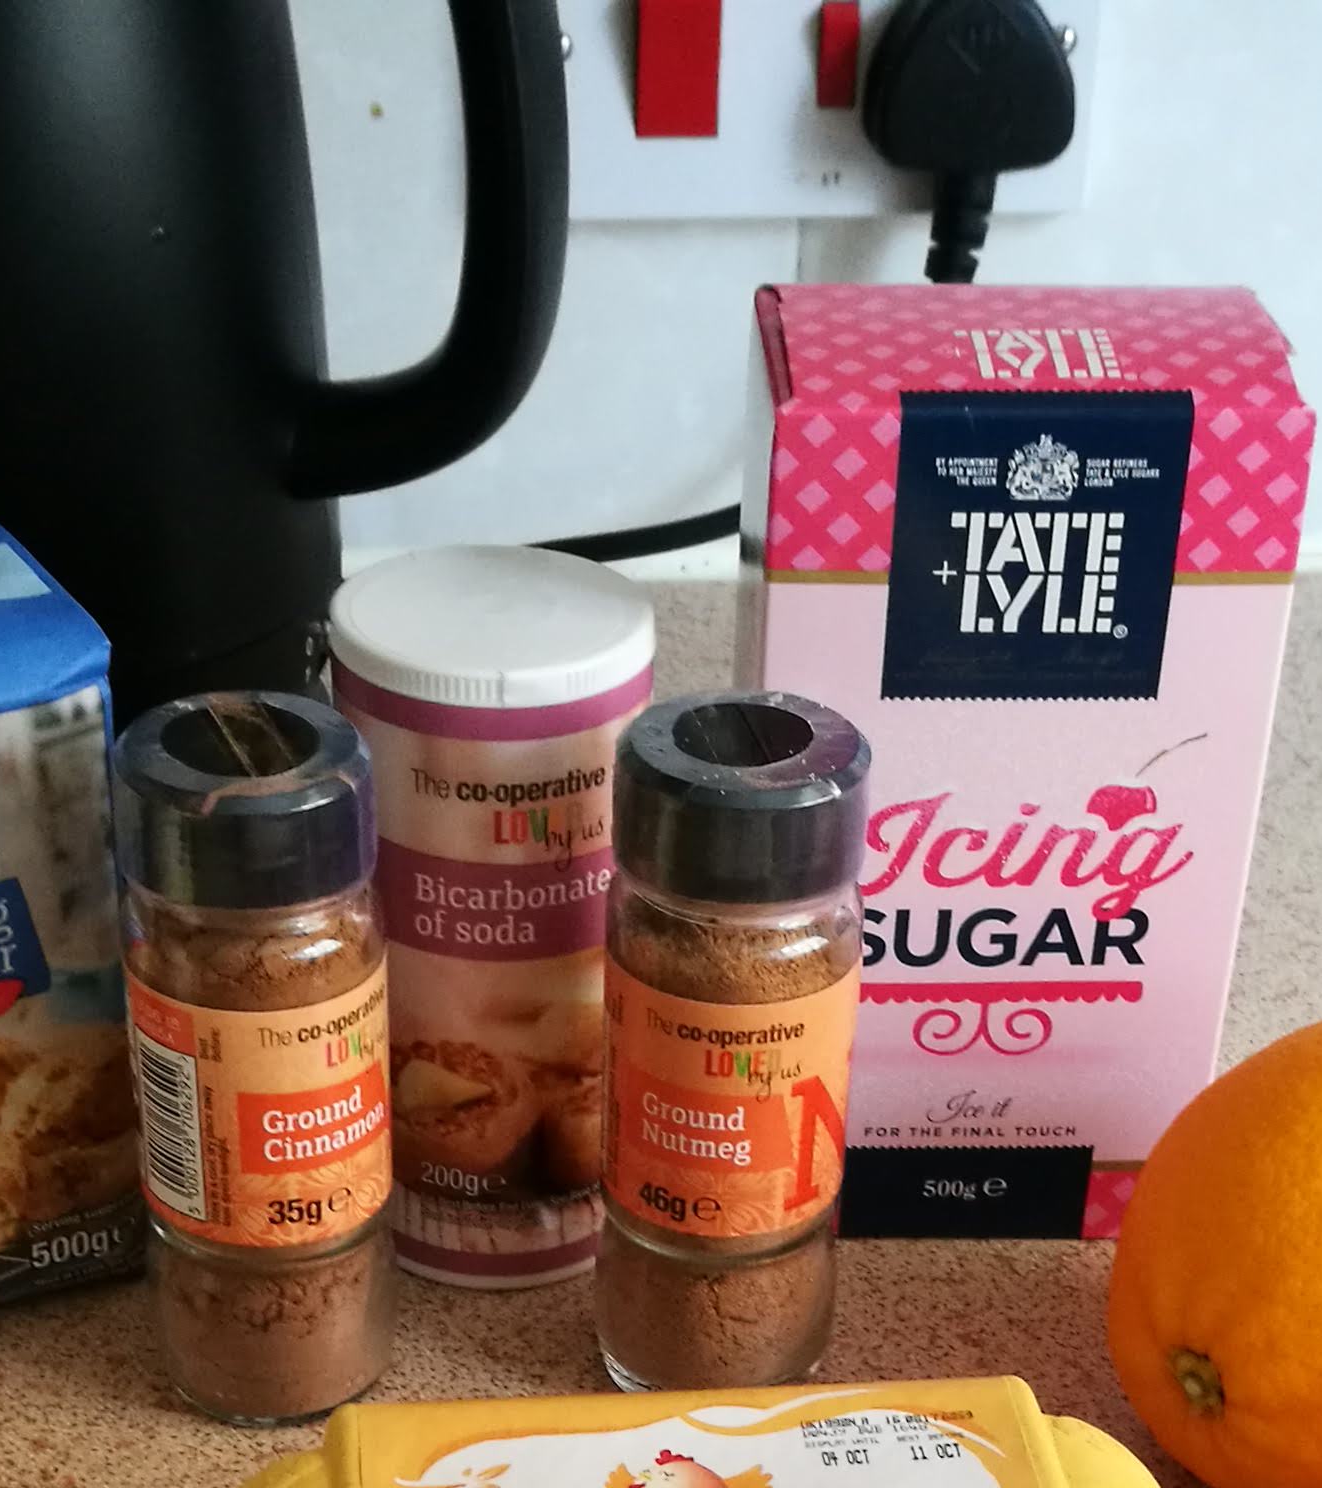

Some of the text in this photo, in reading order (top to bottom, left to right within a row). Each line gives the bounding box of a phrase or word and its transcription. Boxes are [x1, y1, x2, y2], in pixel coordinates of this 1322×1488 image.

[950, 512, 1125, 573] TATE
[959, 573, 1114, 633] LYLE
[410, 765, 607, 808] The co-operative
[859, 792, 1195, 922] Icing
[413, 867, 612, 912] Bicarbonate
[415, 911, 537, 945] of soda
[258, 1026, 293, 1049] The
[645, 1007, 806, 1049] The co-operative
[262, 1085, 364, 1135] Ground
[641, 1091, 746, 1132] Ground
[863, 1124, 1077, 1138] FOR THE FINAL TOUCH
[263, 1101, 386, 1162] Cinnamon
[640, 1119, 753, 1166] Nutmeg
[420, 1161, 479, 1197] 200g
[922, 1179, 978, 1200] 500g
[268, 1198, 323, 1226] 35g
[638, 1181, 687, 1223] 46g
[30, 1229, 109, 1270] 500g
[821, 1443, 962, 1467] 04 OCT 11 OCT
